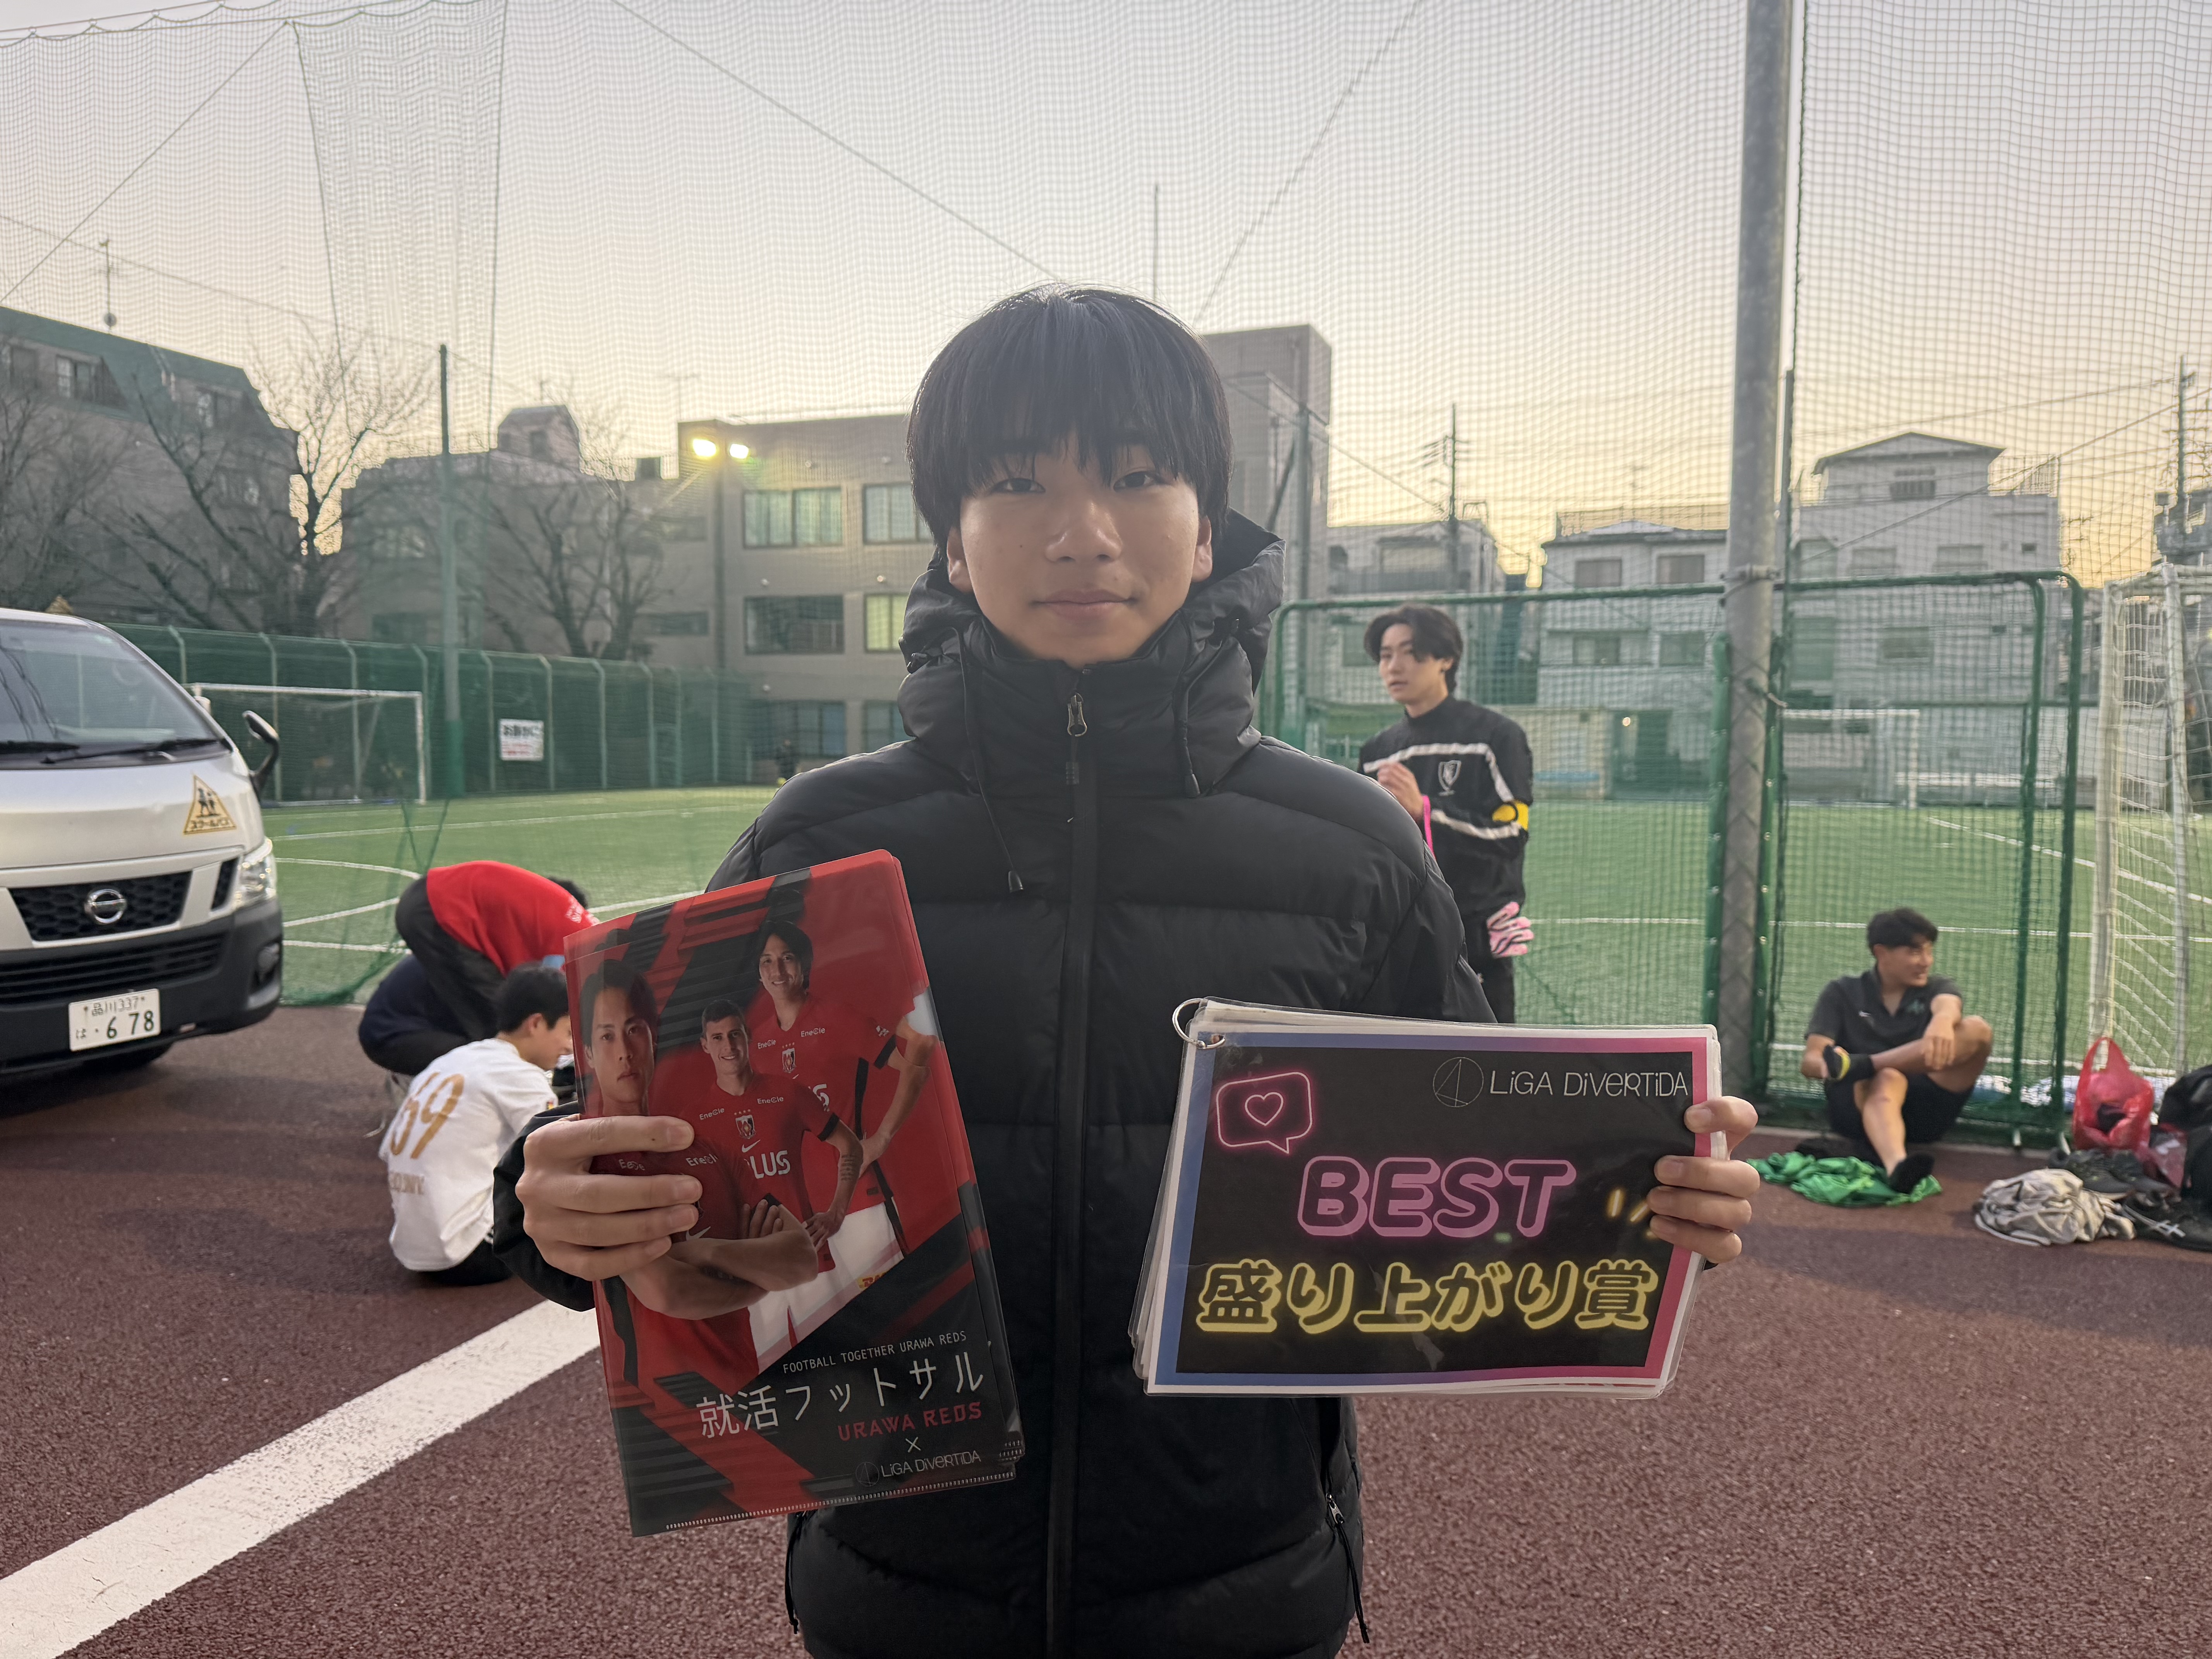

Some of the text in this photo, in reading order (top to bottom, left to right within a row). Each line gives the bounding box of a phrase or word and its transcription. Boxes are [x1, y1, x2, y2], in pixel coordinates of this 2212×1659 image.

[118, 996, 139, 1012] 337
[1297, 1156, 1577, 1238] BEST
[1196, 1258, 1659, 1334] 盛り上がり賞
[783, 1331, 967, 1374] FOOTBALL TOGETHER URAWA REDS
[696, 1351, 984, 1439] 就活フットサル
[837, 1402, 983, 1442] URAWA REDS
